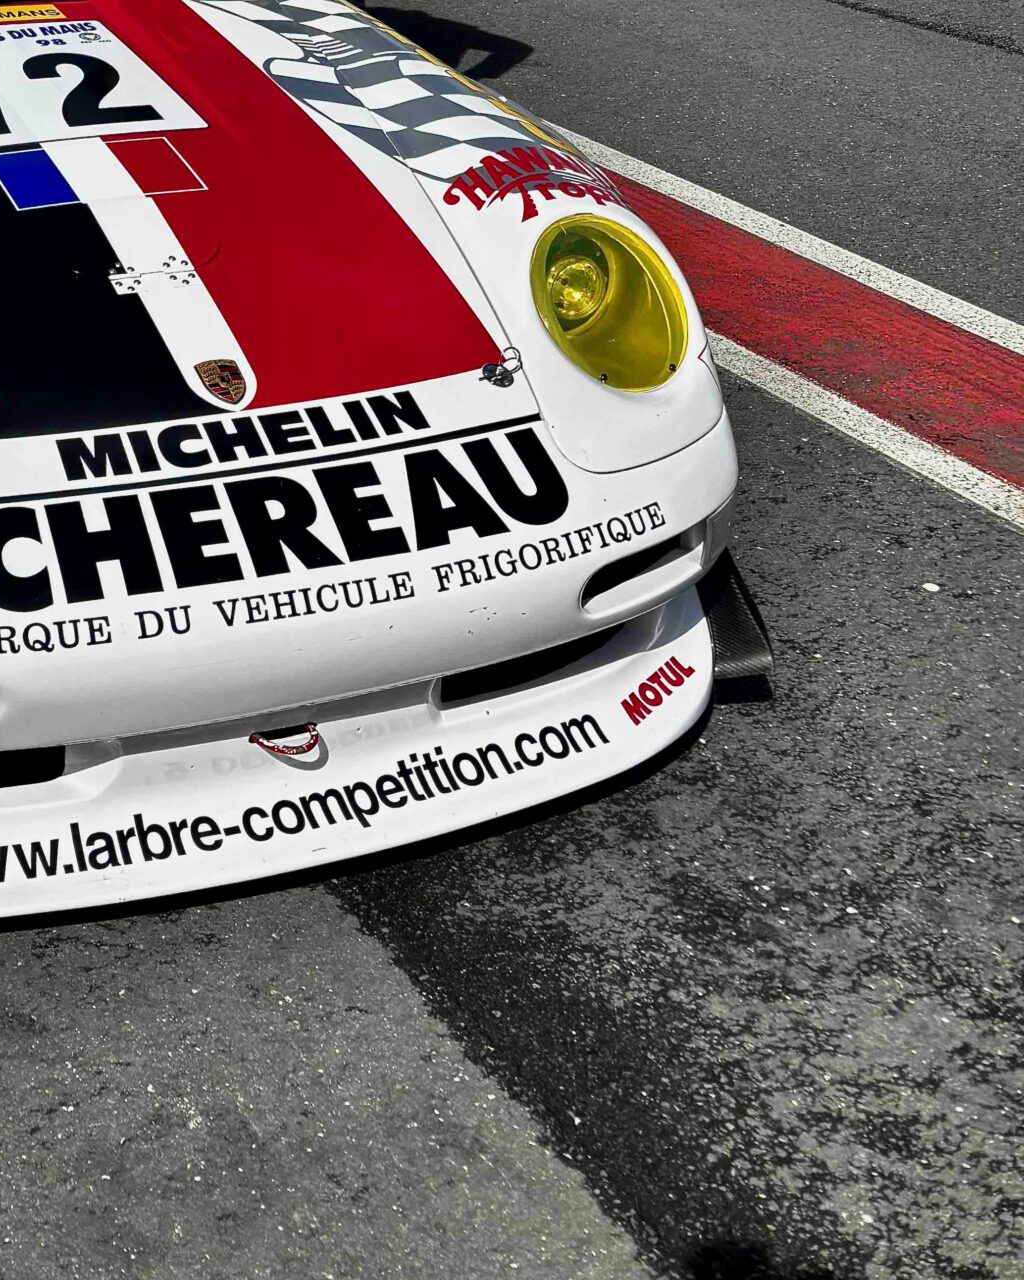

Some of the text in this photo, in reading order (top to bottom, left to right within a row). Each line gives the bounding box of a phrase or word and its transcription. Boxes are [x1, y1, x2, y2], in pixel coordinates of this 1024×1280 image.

[8, 26, 40, 40] DU
[41, 21, 98, 37] MANS
[36, 37, 67, 48] 98
[56, 391, 429, 482] MICHELIN
[136, 605, 192, 640] DU
[216, 571, 414, 627] VEHICULE
[437, 502, 666, 593] FRIGORIFIQUE
[621, 656, 696, 726] MOTUL
